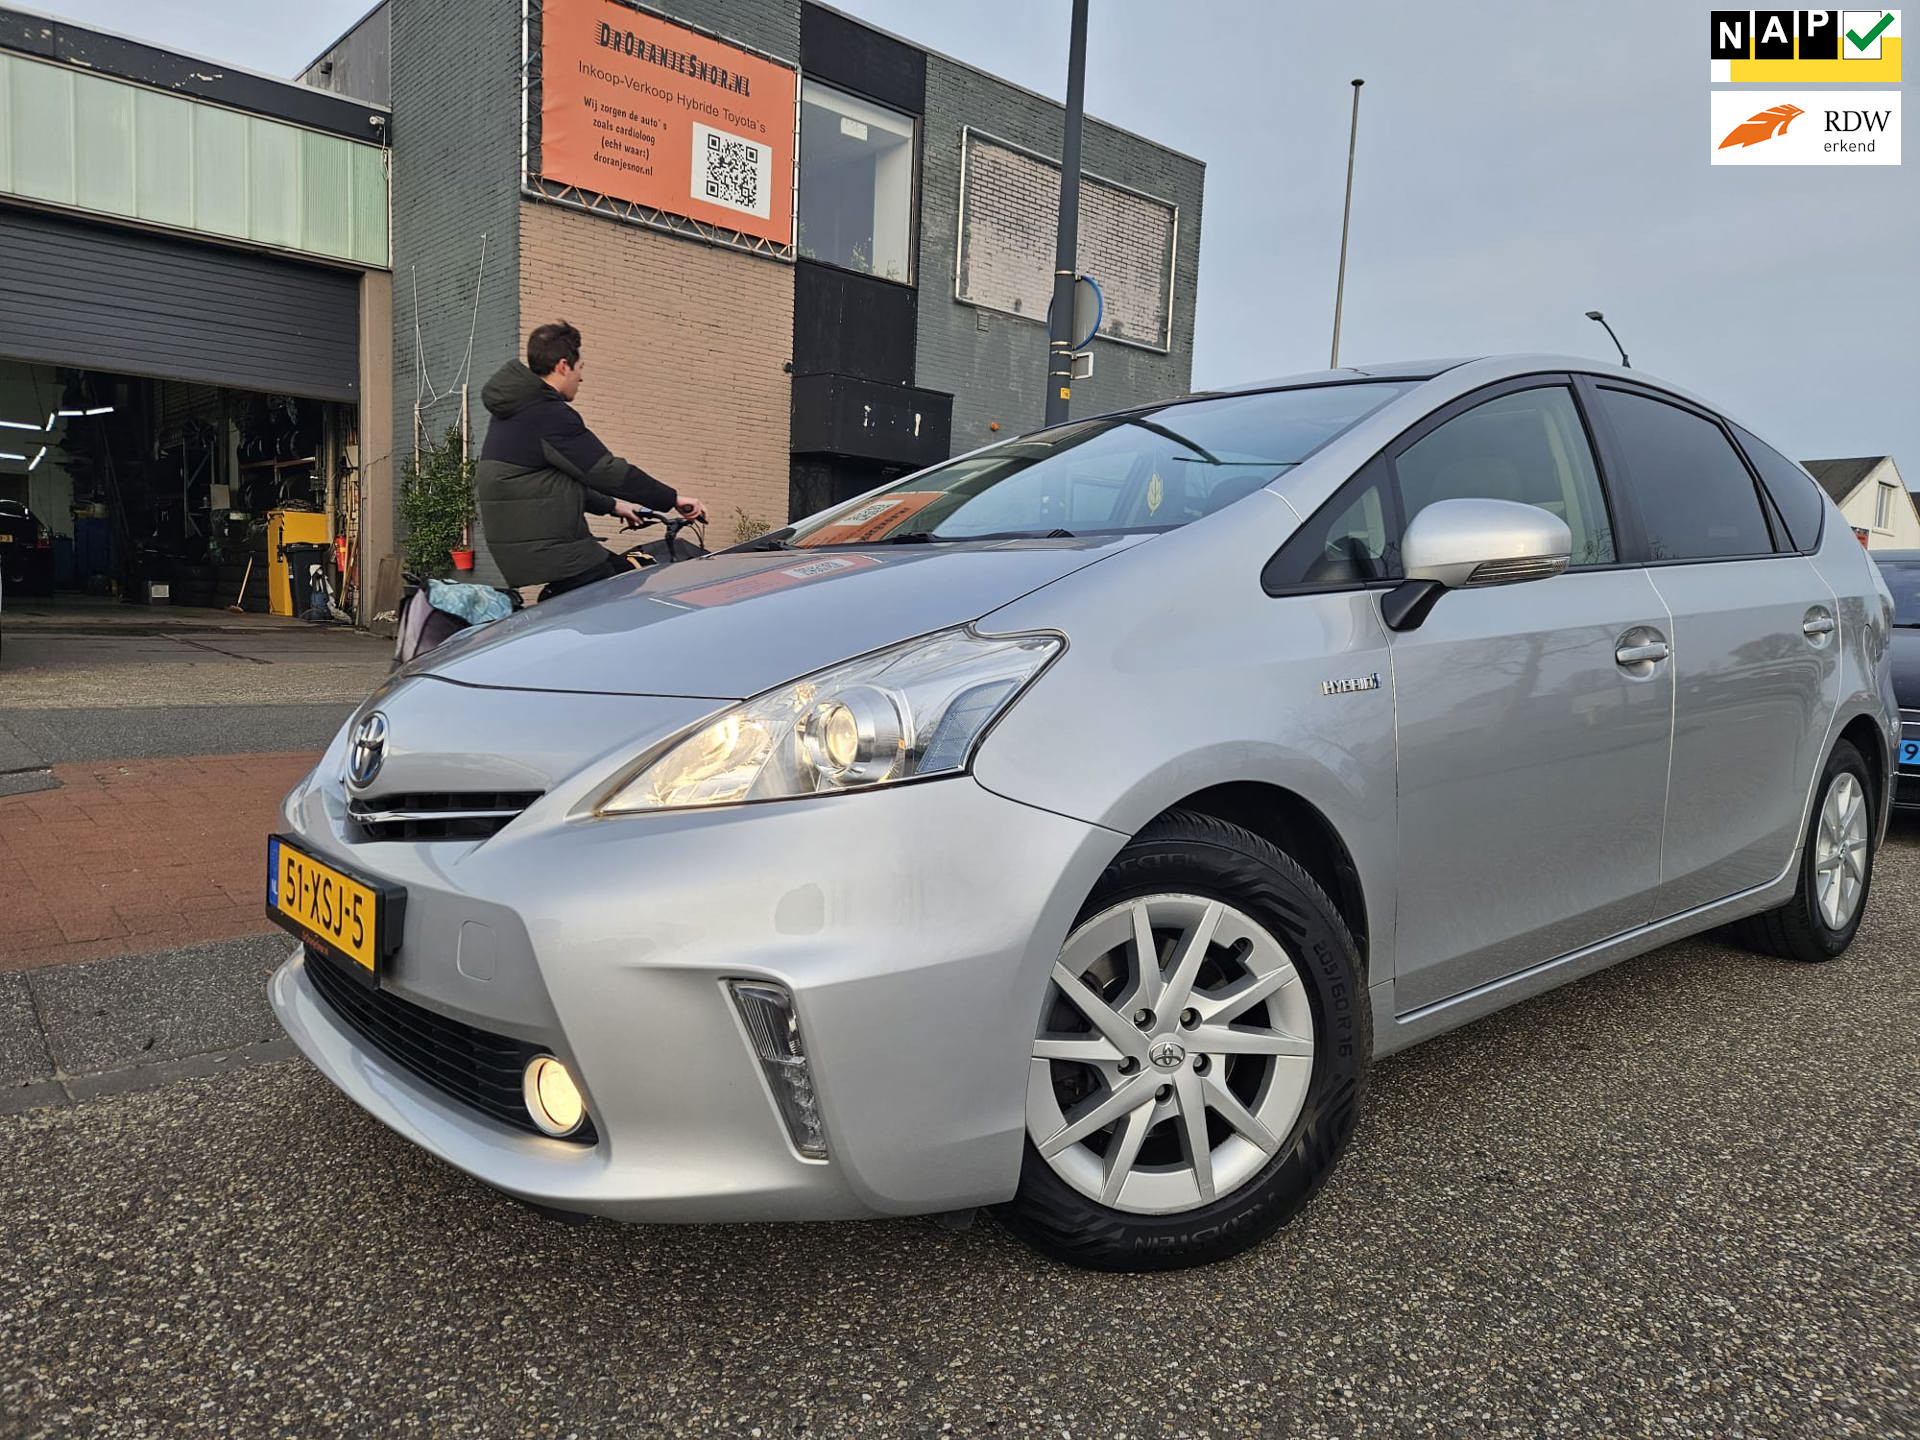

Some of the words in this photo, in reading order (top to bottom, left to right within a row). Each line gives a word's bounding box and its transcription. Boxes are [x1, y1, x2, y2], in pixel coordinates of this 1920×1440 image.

[579, 60, 673, 103] Inkoop-Verkoop
[677, 92, 719, 117] Hybride
[584, 96, 598, 112] Wij
[600, 103, 627, 118] zorgen
[629, 110, 638, 121] de
[593, 119, 613, 131] zoals
[615, 127, 656, 146] cardioloog
[601, 136, 622, 151] (echt
[593, 151, 653, 176] droranjesnor.nl
[1322, 677, 1374, 695] HYBRID
[286, 858, 364, 949] 51-XSJ-5
